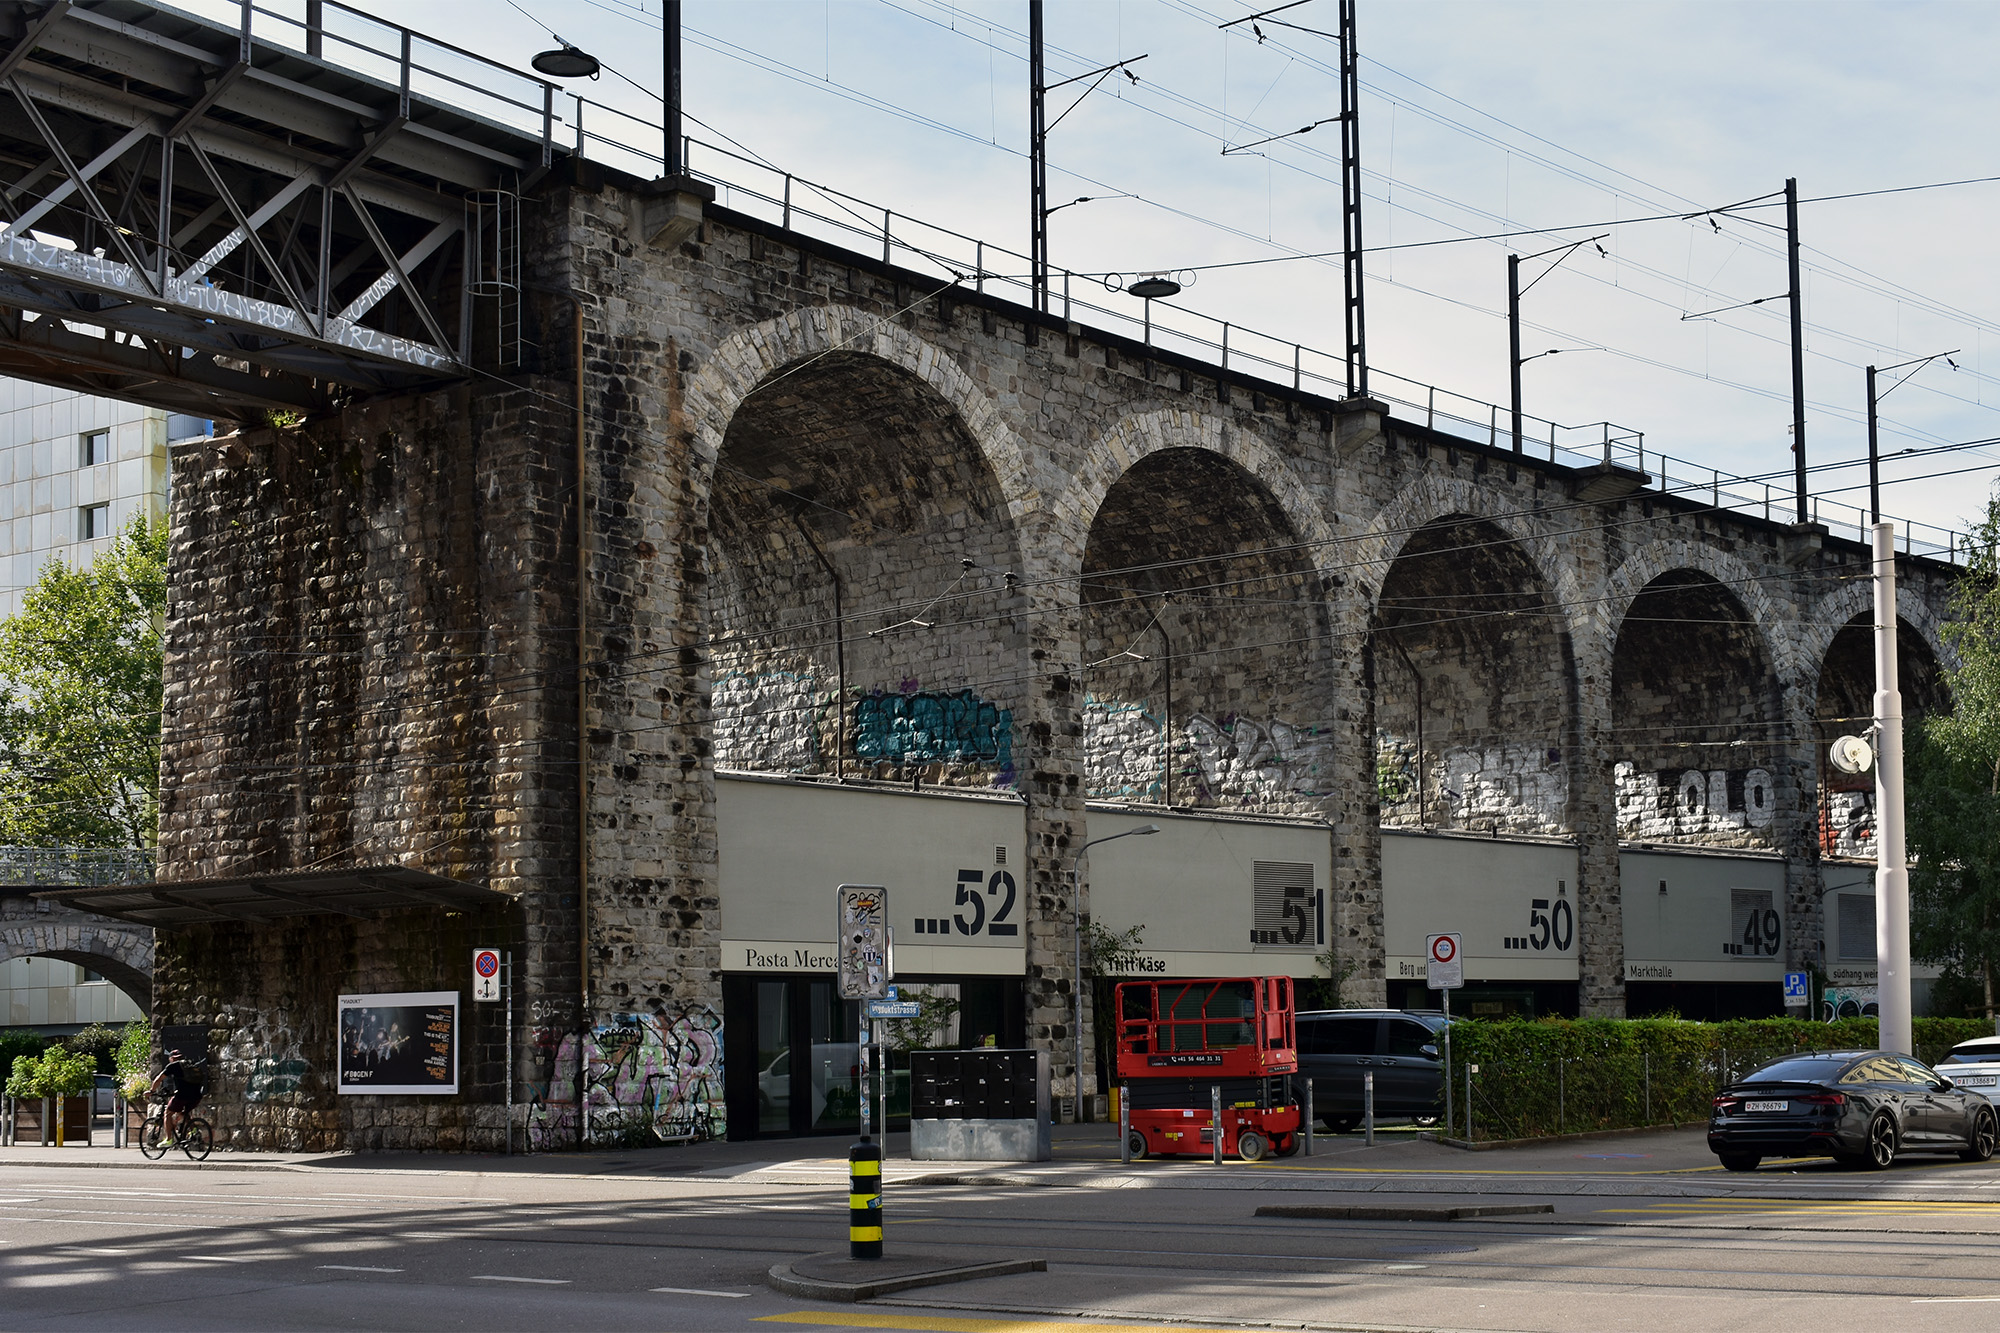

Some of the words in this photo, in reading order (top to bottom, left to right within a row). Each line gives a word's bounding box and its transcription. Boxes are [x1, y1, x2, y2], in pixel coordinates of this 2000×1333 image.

[745, 948, 789, 968] Pasta
[1139, 956, 1165, 972] Käse
[1399, 961, 1415, 977] Berg
[1630, 965, 1673, 978] Markthalle
[1833, 968, 1862, 981] südhang
[1751, 1102, 1760, 1110] ZH
[1762, 1102, 1782, 1110] 96679
